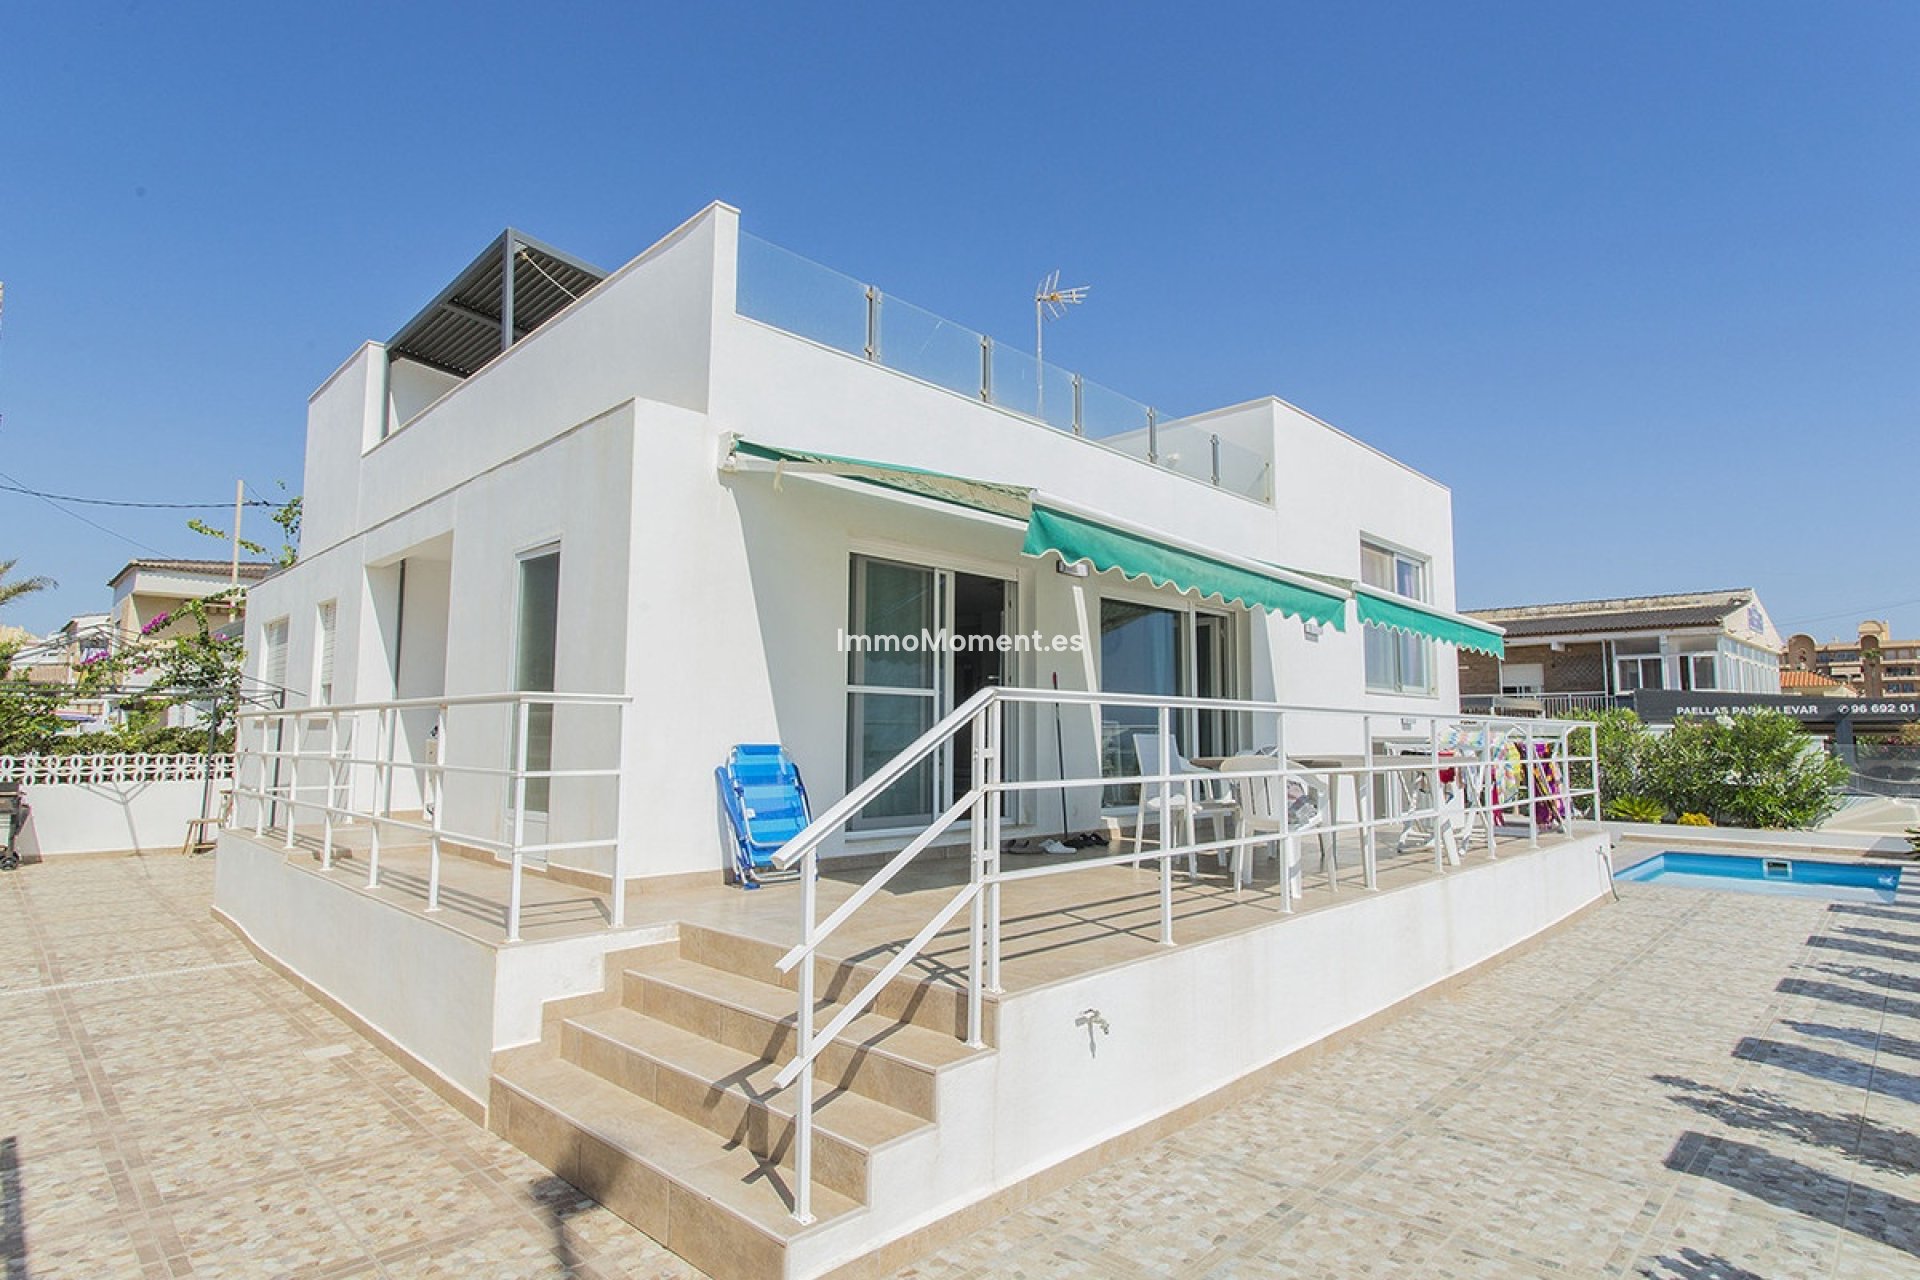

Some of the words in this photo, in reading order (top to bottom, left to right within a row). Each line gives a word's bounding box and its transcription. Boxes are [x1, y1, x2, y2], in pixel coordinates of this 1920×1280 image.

[1850, 703, 1868, 714] 96
[1871, 703, 1896, 713] 692
[1899, 703, 1916, 713] 01
